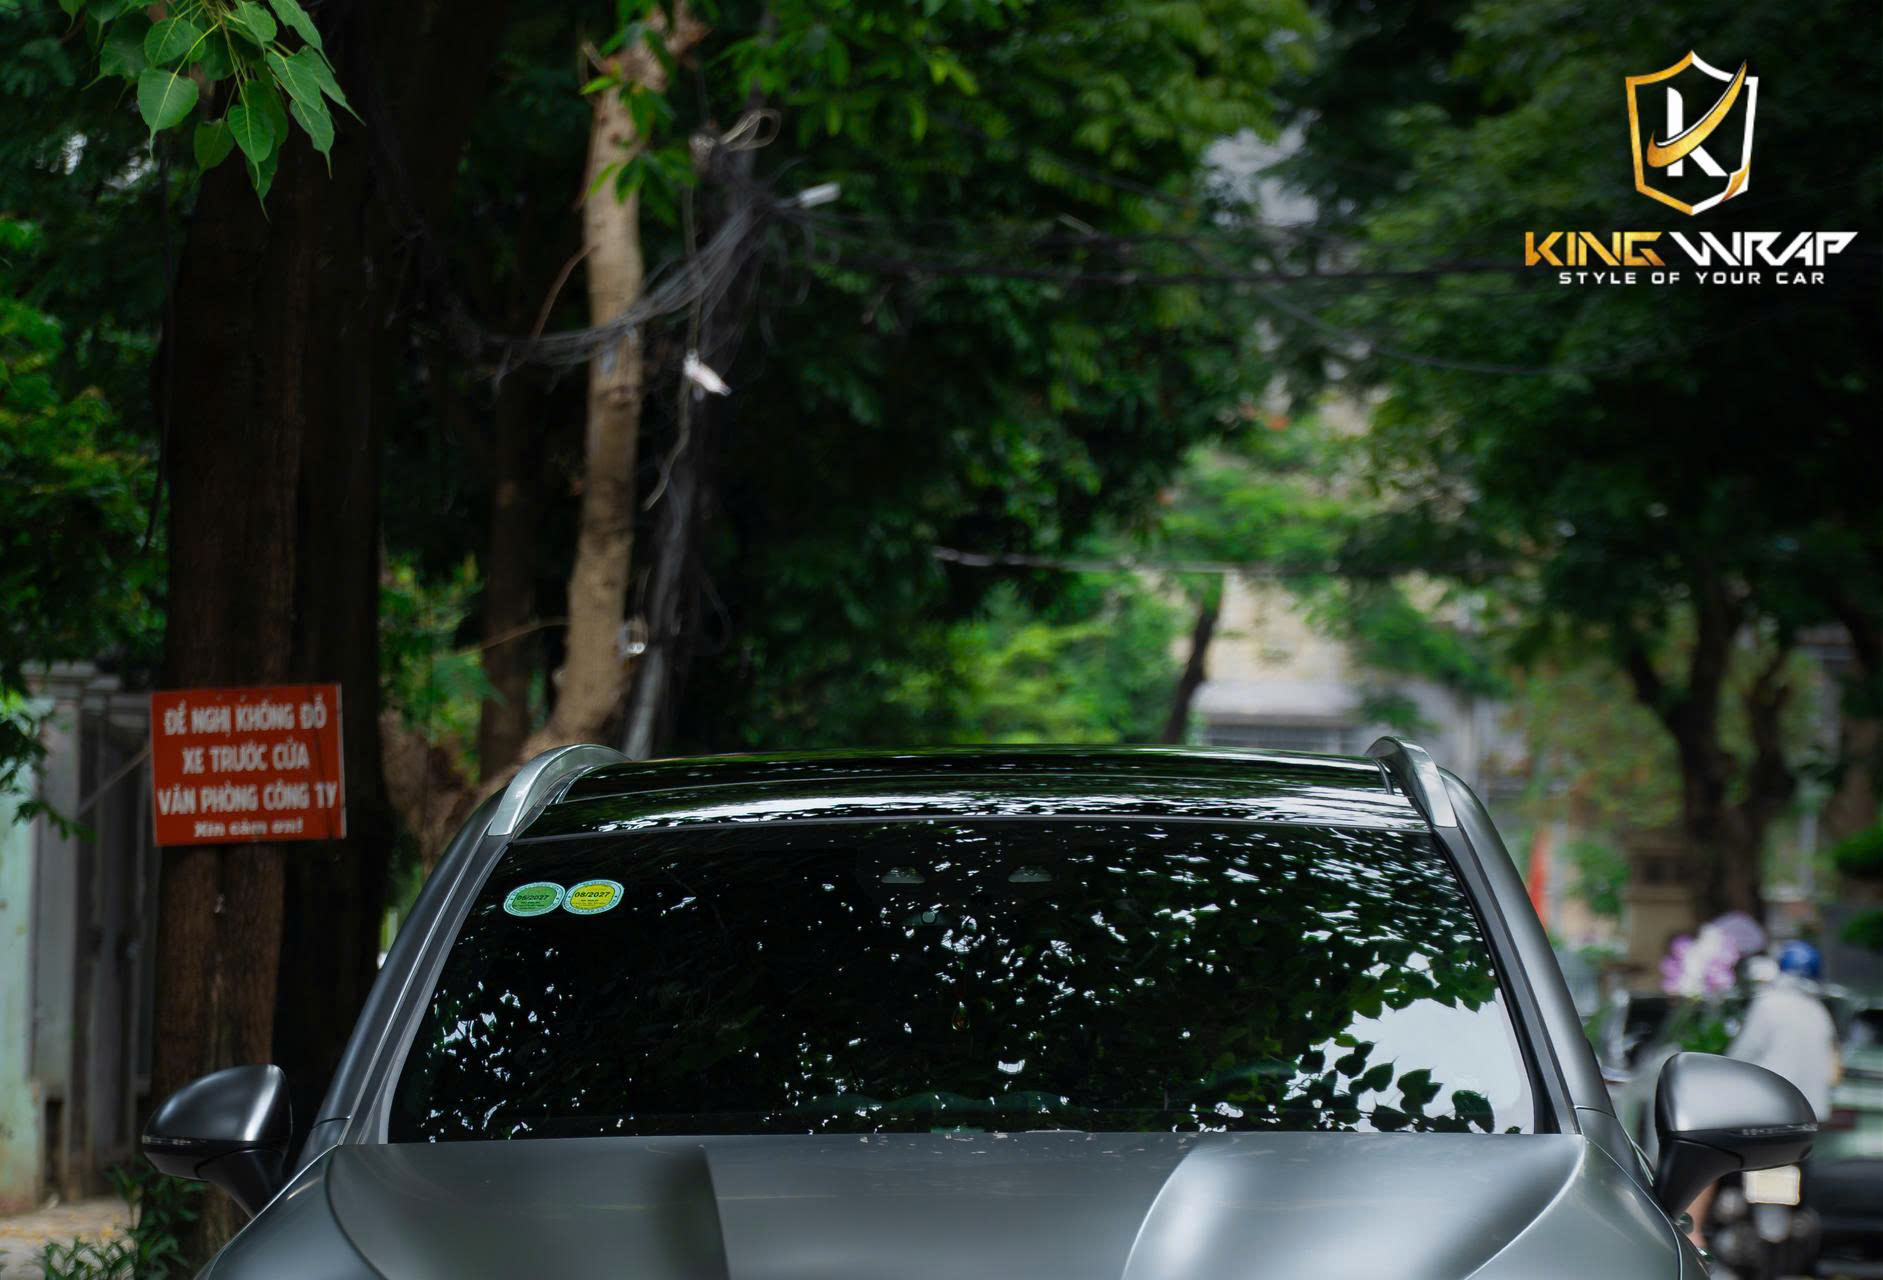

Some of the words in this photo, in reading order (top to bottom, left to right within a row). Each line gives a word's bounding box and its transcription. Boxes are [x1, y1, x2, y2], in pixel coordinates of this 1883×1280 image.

[182, 747, 205, 775] XE
[158, 784, 196, 815] VĂN
[200, 780, 259, 813] PHÒNG
[263, 778, 310, 811] CÔNG
[315, 782, 338, 809] TY
